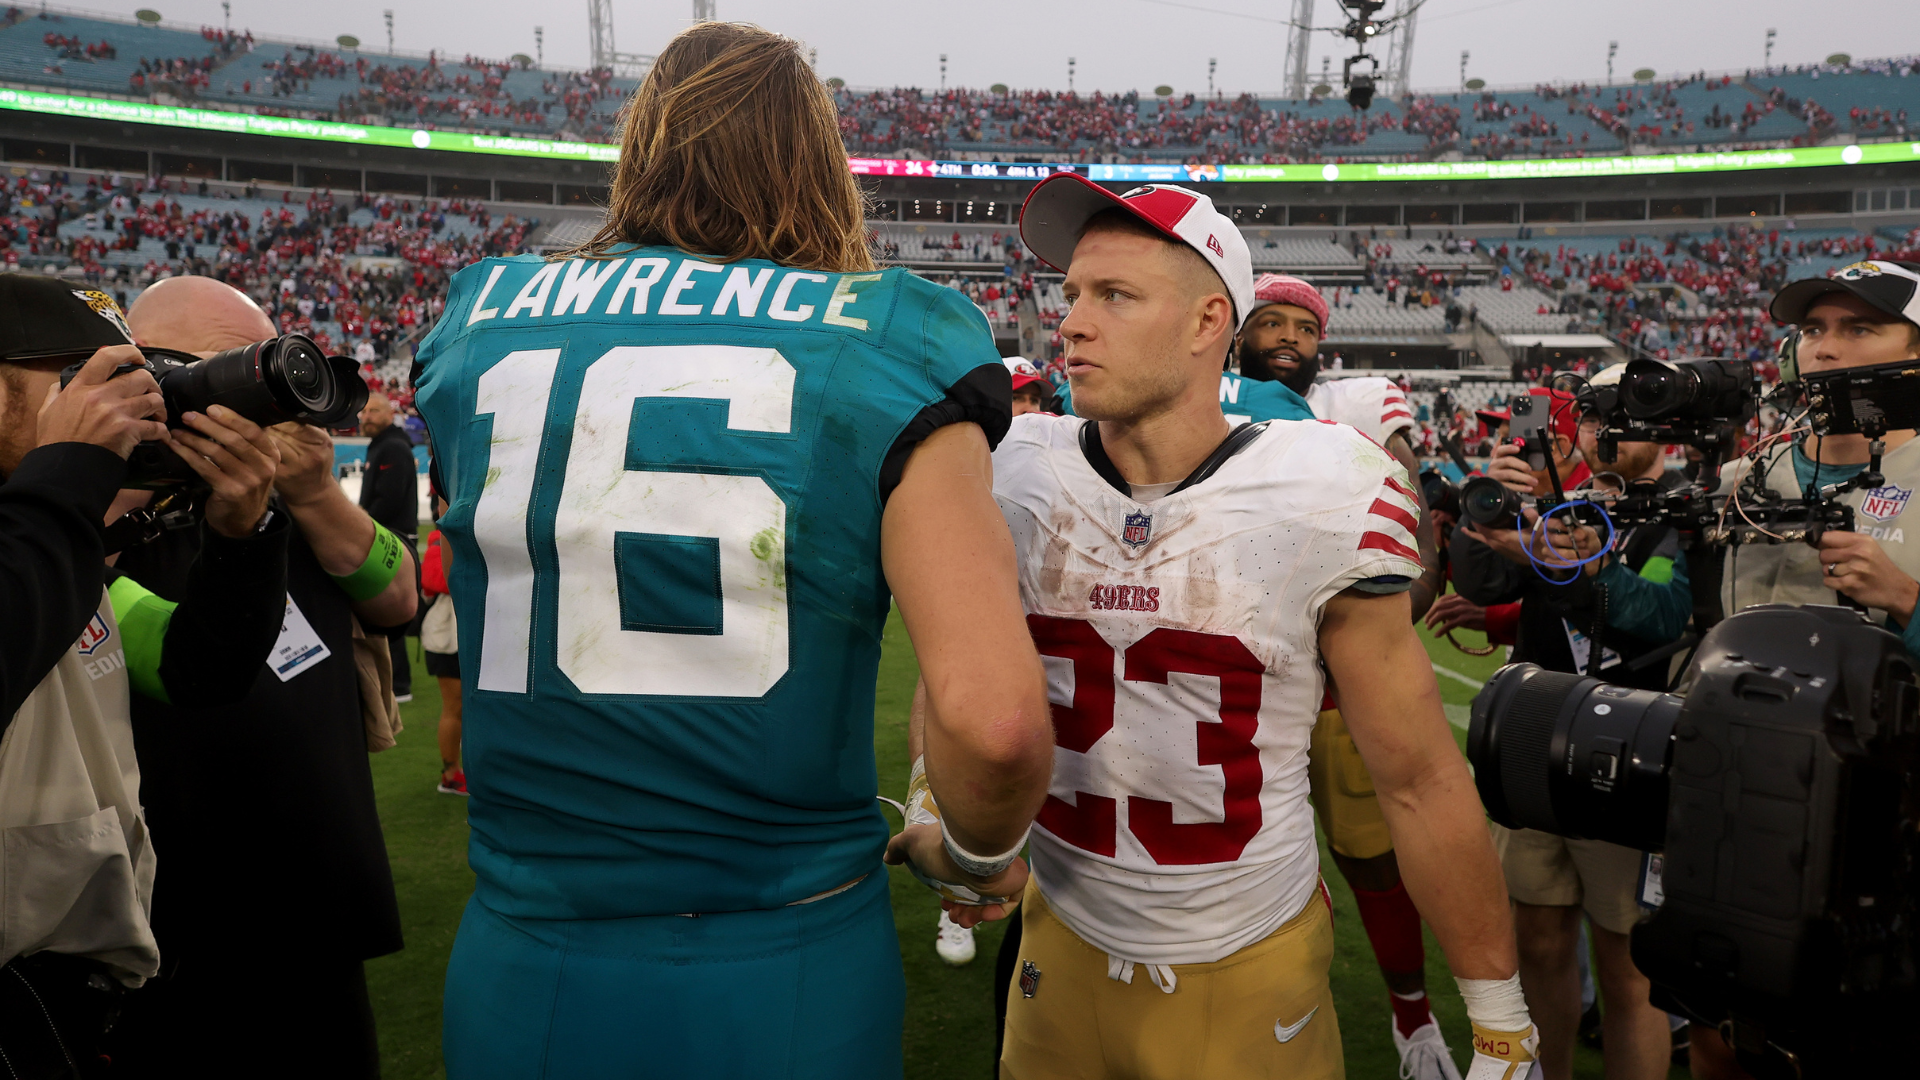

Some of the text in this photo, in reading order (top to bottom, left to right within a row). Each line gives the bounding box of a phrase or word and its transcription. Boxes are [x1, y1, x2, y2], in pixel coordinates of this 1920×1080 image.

[198, 112, 246, 126] Ultimate
[247, 115, 289, 131] Tailgate
[290, 120, 319, 136] Party
[495, 138, 538, 151] JAGUARS
[905, 161, 923, 175] 34
[940, 163, 962, 175] 4TH
[971, 164, 998, 177] 0:04
[1027, 166, 1036, 177] &
[1037, 166, 1050, 178] 13
[1104, 166, 1113, 179] 3
[1397, 164, 1439, 175] JAGUARS
[466, 257, 883, 331] LAWRENCE
[1866, 498, 1899, 517] NFL
[474, 345, 797, 698] 16
[1125, 526, 1146, 541] NFL
[1089, 582, 1160, 613] 49ERS
[1027, 613, 1266, 866] 23
